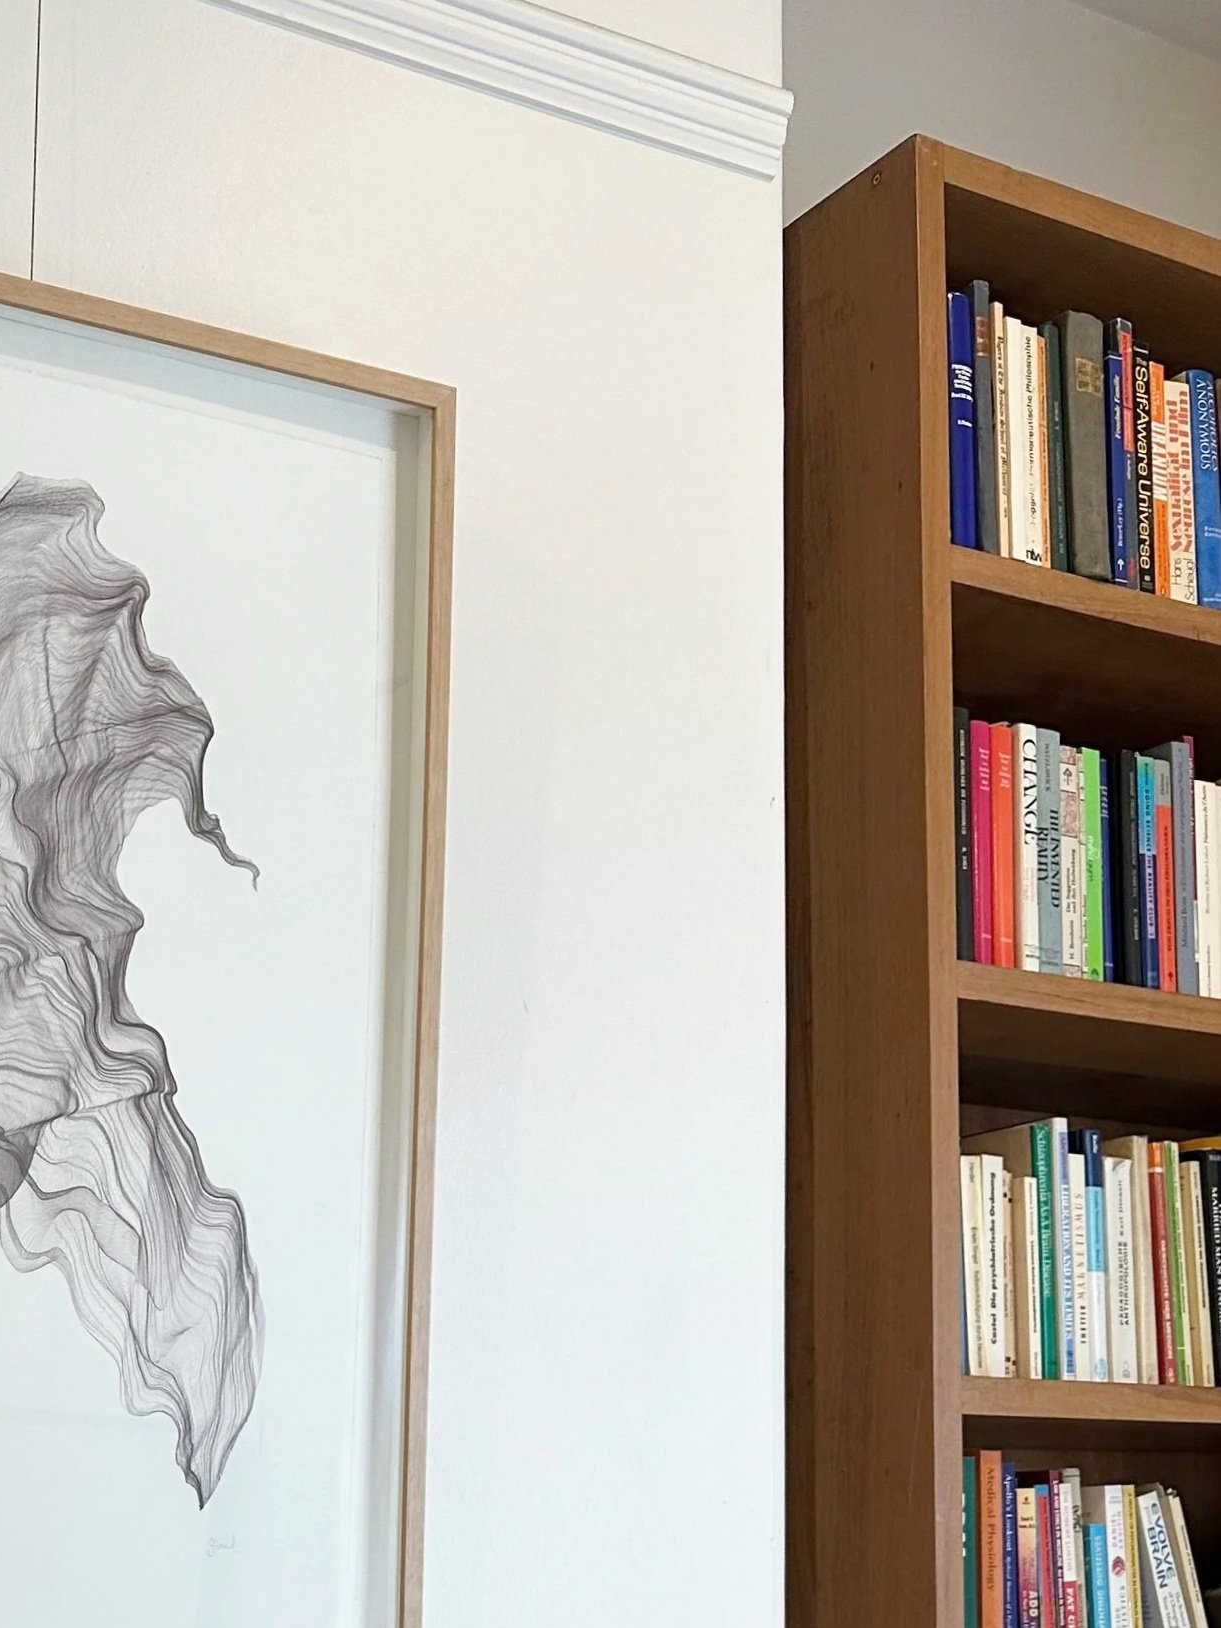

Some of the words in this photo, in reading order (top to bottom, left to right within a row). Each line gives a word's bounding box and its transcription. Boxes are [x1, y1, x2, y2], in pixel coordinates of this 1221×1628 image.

[1025, 336, 1033, 393] Philosophie
[1135, 366, 1150, 475] Self-Aware
[1166, 400, 1181, 444] und
[1177, 391, 1190, 438] Film
[1196, 378, 1210, 471] ANONYMOUS
[1151, 421, 1169, 502] URANIUM
[1138, 480, 1153, 569] Universe
[1166, 452, 1182, 551] Sexualität
[1179, 473, 1193, 551] Neurose
[1171, 558, 1183, 586] Hans
[1183, 558, 1195, 601] Scheugl
[1023, 739, 1039, 846] CHANGE
[1144, 789, 1152, 816] DOING
[1049, 809, 1059, 836] THE
[1145, 820, 1153, 853] SCIENCE
[1037, 827, 1049, 885] REALITY
[1050, 837, 1061, 909] INVENTED
[1037, 1128, 1051, 1202] Schizophrenia
[988, 1172, 997, 1218] Ordnung
[1040, 1203, 1050, 1216] As
[1060, 1184, 1073, 1248] LIBERATION
[1210, 1186, 1221, 1244] MARRIED
[1040, 1216, 1050, 1228] A
[1041, 1229, 1052, 1257] Brain
[1075, 1191, 1086, 1300] MAGNETISMUS
[988, 1219, 998, 1290] psychiatrische
[1042, 1259, 1053, 1298] Disease
[1062, 1251, 1073, 1277] AND
[989, 1291, 997, 1310] Die
[1063, 1280, 1073, 1299] ITS
[1122, 1241, 1130, 1326] ANTHROPOLOGIE
[1064, 1301, 1075, 1340] LIMITS
[986, 1467, 997, 1518] Medical
[1003, 1474, 1013, 1511] Apollo's
[1005, 1513, 1014, 1552] Lookout
[1110, 1512, 1118, 1548] DANIEL
[1151, 1502, 1176, 1580] EVOLVE
[987, 1523, 998, 1592] Physiology
[1095, 1535, 1105, 1586] OURSELVES
[1147, 1527, 1167, 1590] BRAIN
[1028, 1590, 1039, 1617] ADD
[1066, 1588, 1076, 1614] FAT
